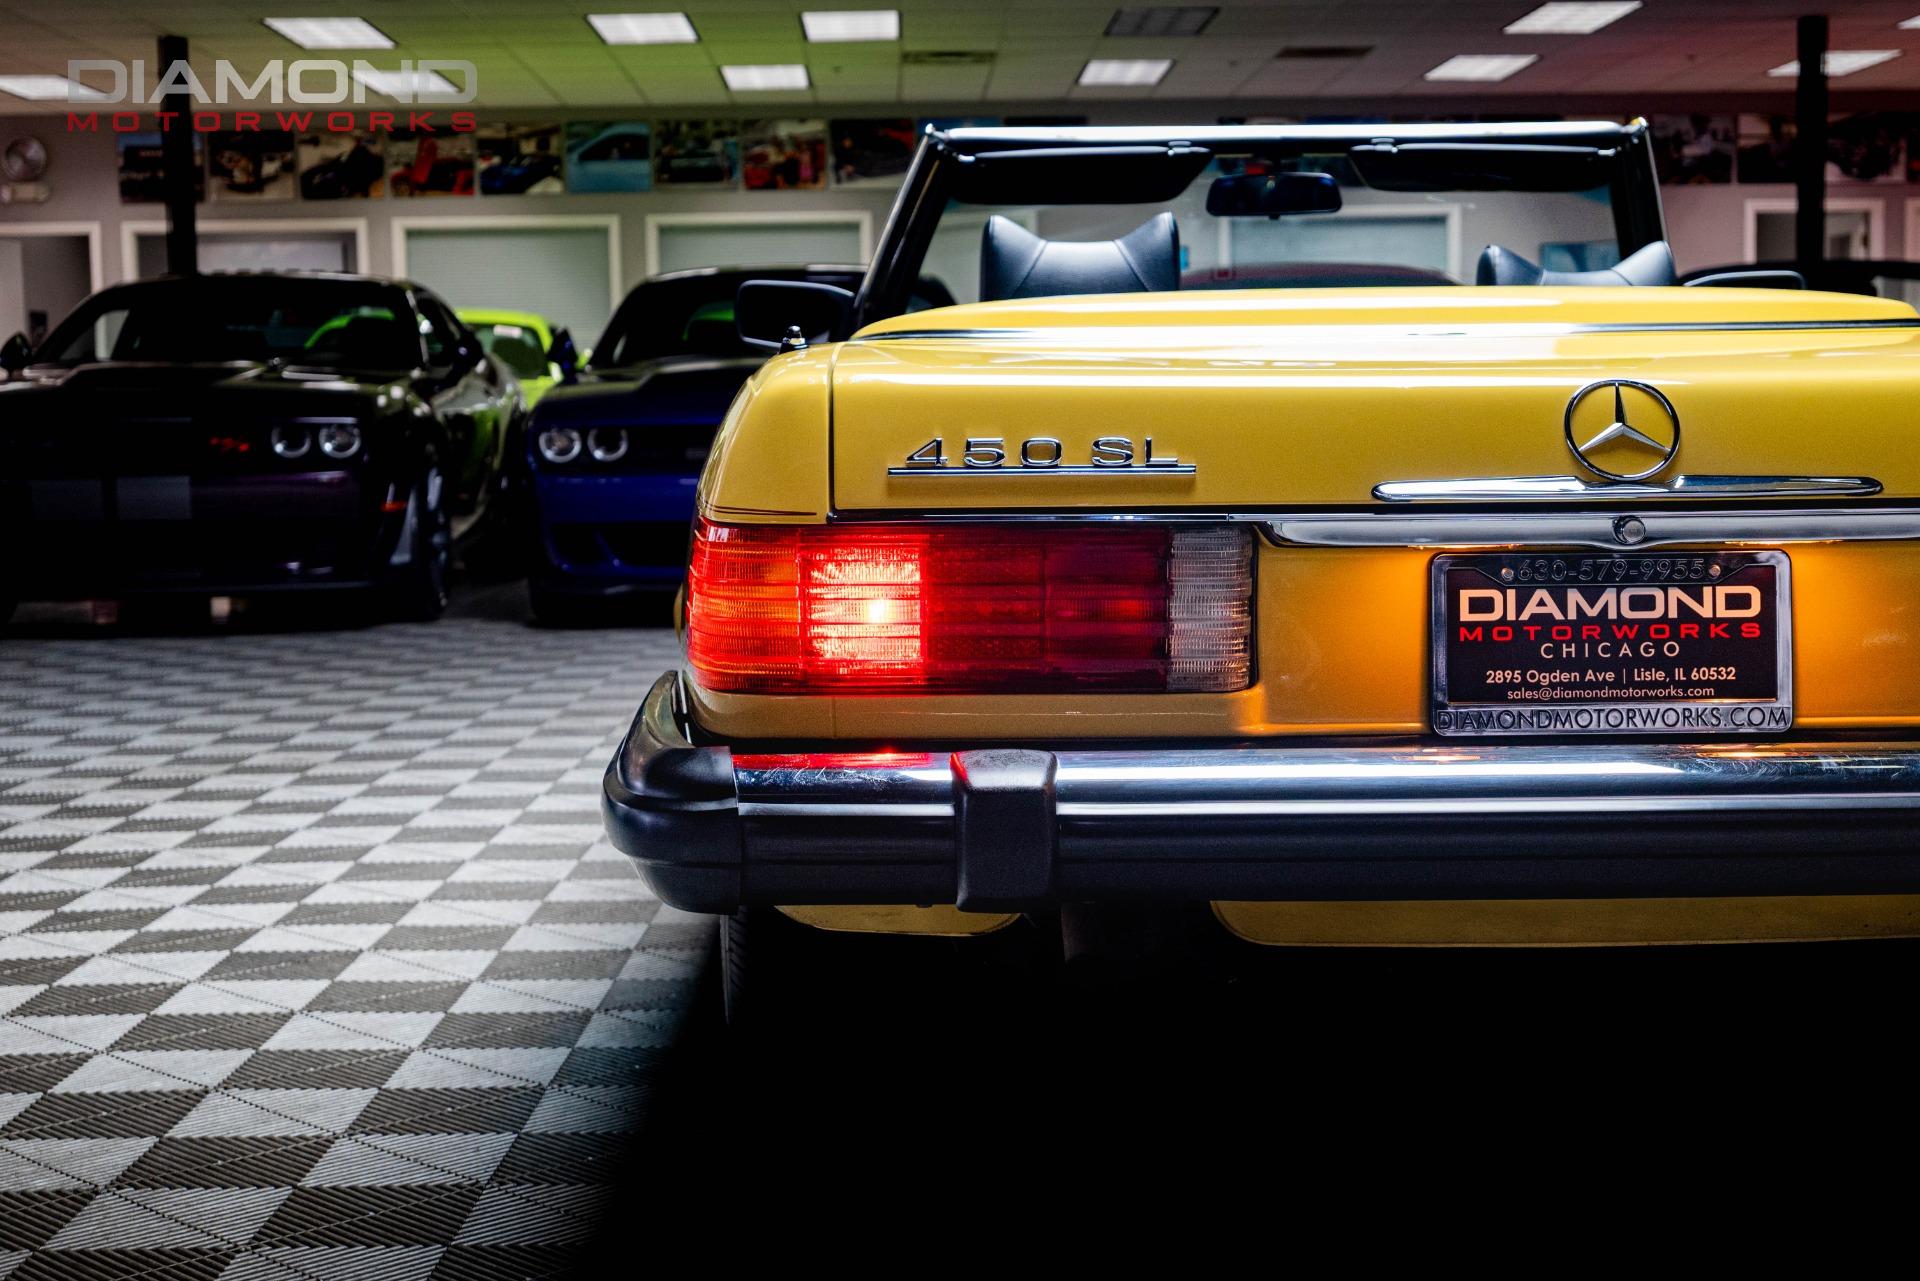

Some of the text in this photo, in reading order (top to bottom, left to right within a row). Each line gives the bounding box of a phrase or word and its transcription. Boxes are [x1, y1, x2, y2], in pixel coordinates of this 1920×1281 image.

[905, 436, 1179, 467] 450 SL
[1517, 559, 1705, 581] 630-579-9955
[1459, 586, 1761, 622] DIAMOND
[1459, 623, 1761, 642] MOTORWORKS
[1539, 641, 1680, 659] CHICAGO
[1485, 670, 1522, 684] 2895
[1526, 669, 1580, 685] Ogden
[1585, 668, 1615, 682] Ave
[1633, 667, 1670, 682] Lisle,
[1674, 667, 1687, 681] IL
[1690, 667, 1736, 681] 60532
[1507, 685, 1715, 700] sales@diamondmotorworks.com
[1437, 707, 1788, 730] DIAMONDMOTORWORKS.COM
